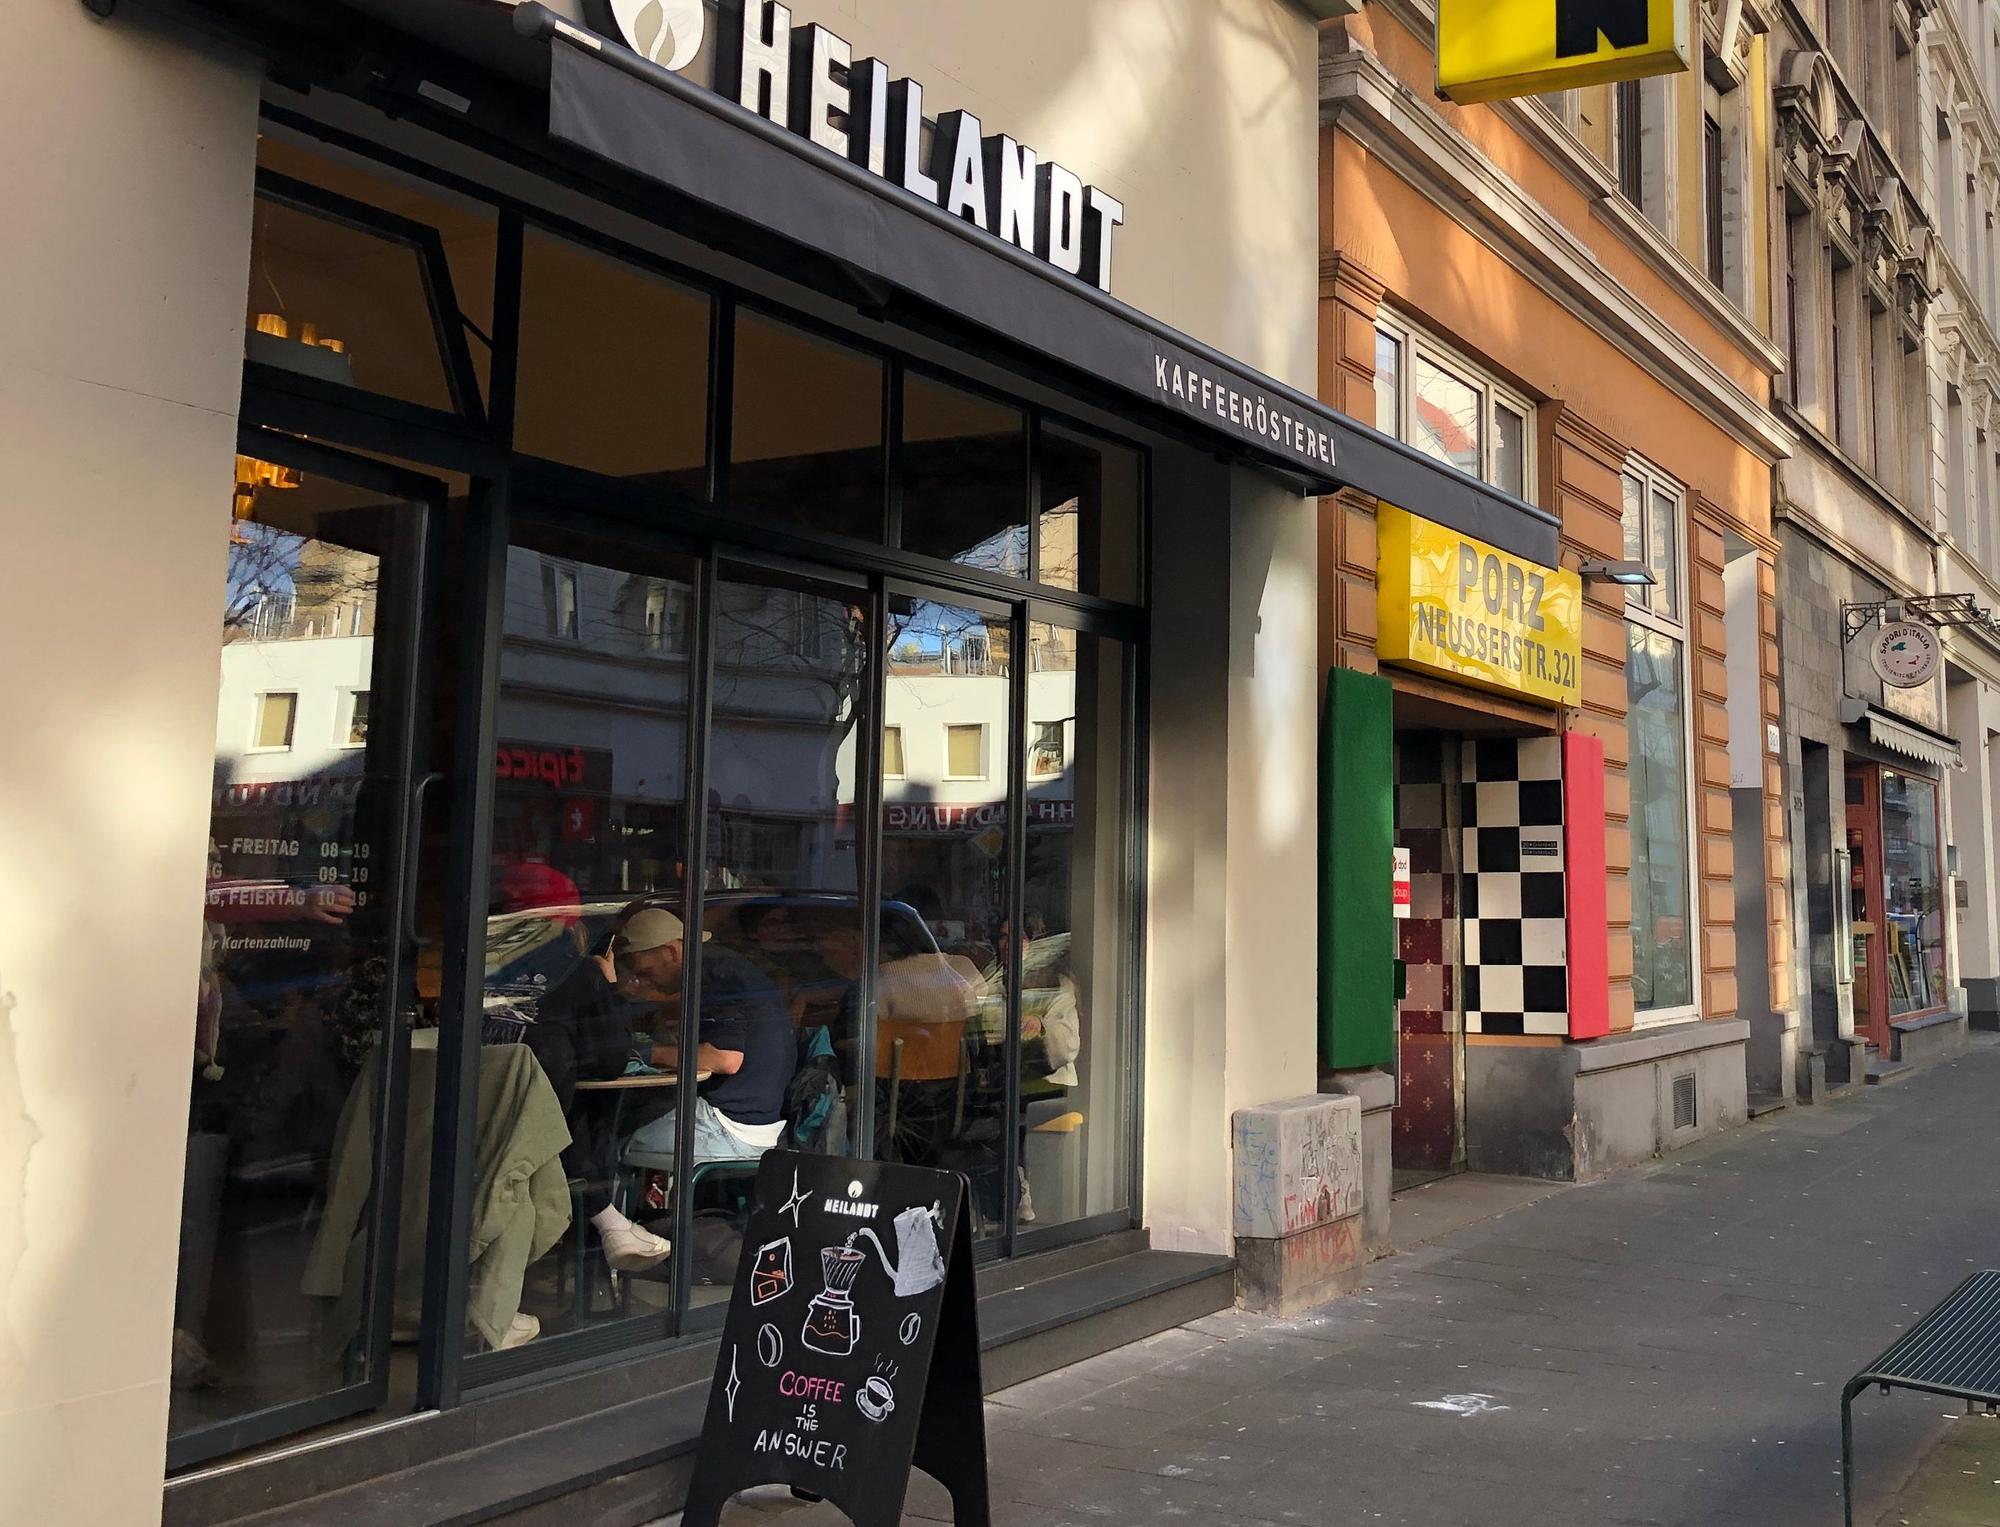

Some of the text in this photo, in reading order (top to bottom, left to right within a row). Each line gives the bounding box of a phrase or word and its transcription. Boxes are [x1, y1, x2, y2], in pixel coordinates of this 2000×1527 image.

[738, 0, 1125, 295] HEILANDT
[1154, 354, 1337, 467] KAFFEERÖSTEREI
[1458, 541, 1546, 632] PORZ
[1879, 630, 1902, 655] SAPORI
[231, 837, 300, 857] FREITAG
[228, 889, 307, 906] FEIERTAG
[221, 935, 312, 951] Kartenzahlung
[823, 1198, 880, 1219] HEILANDT
[779, 1370, 846, 1404] COFFEE
[802, 1404, 817, 1418] IS
[795, 1416, 820, 1432] THE
[753, 1429, 848, 1471] ANSWER
